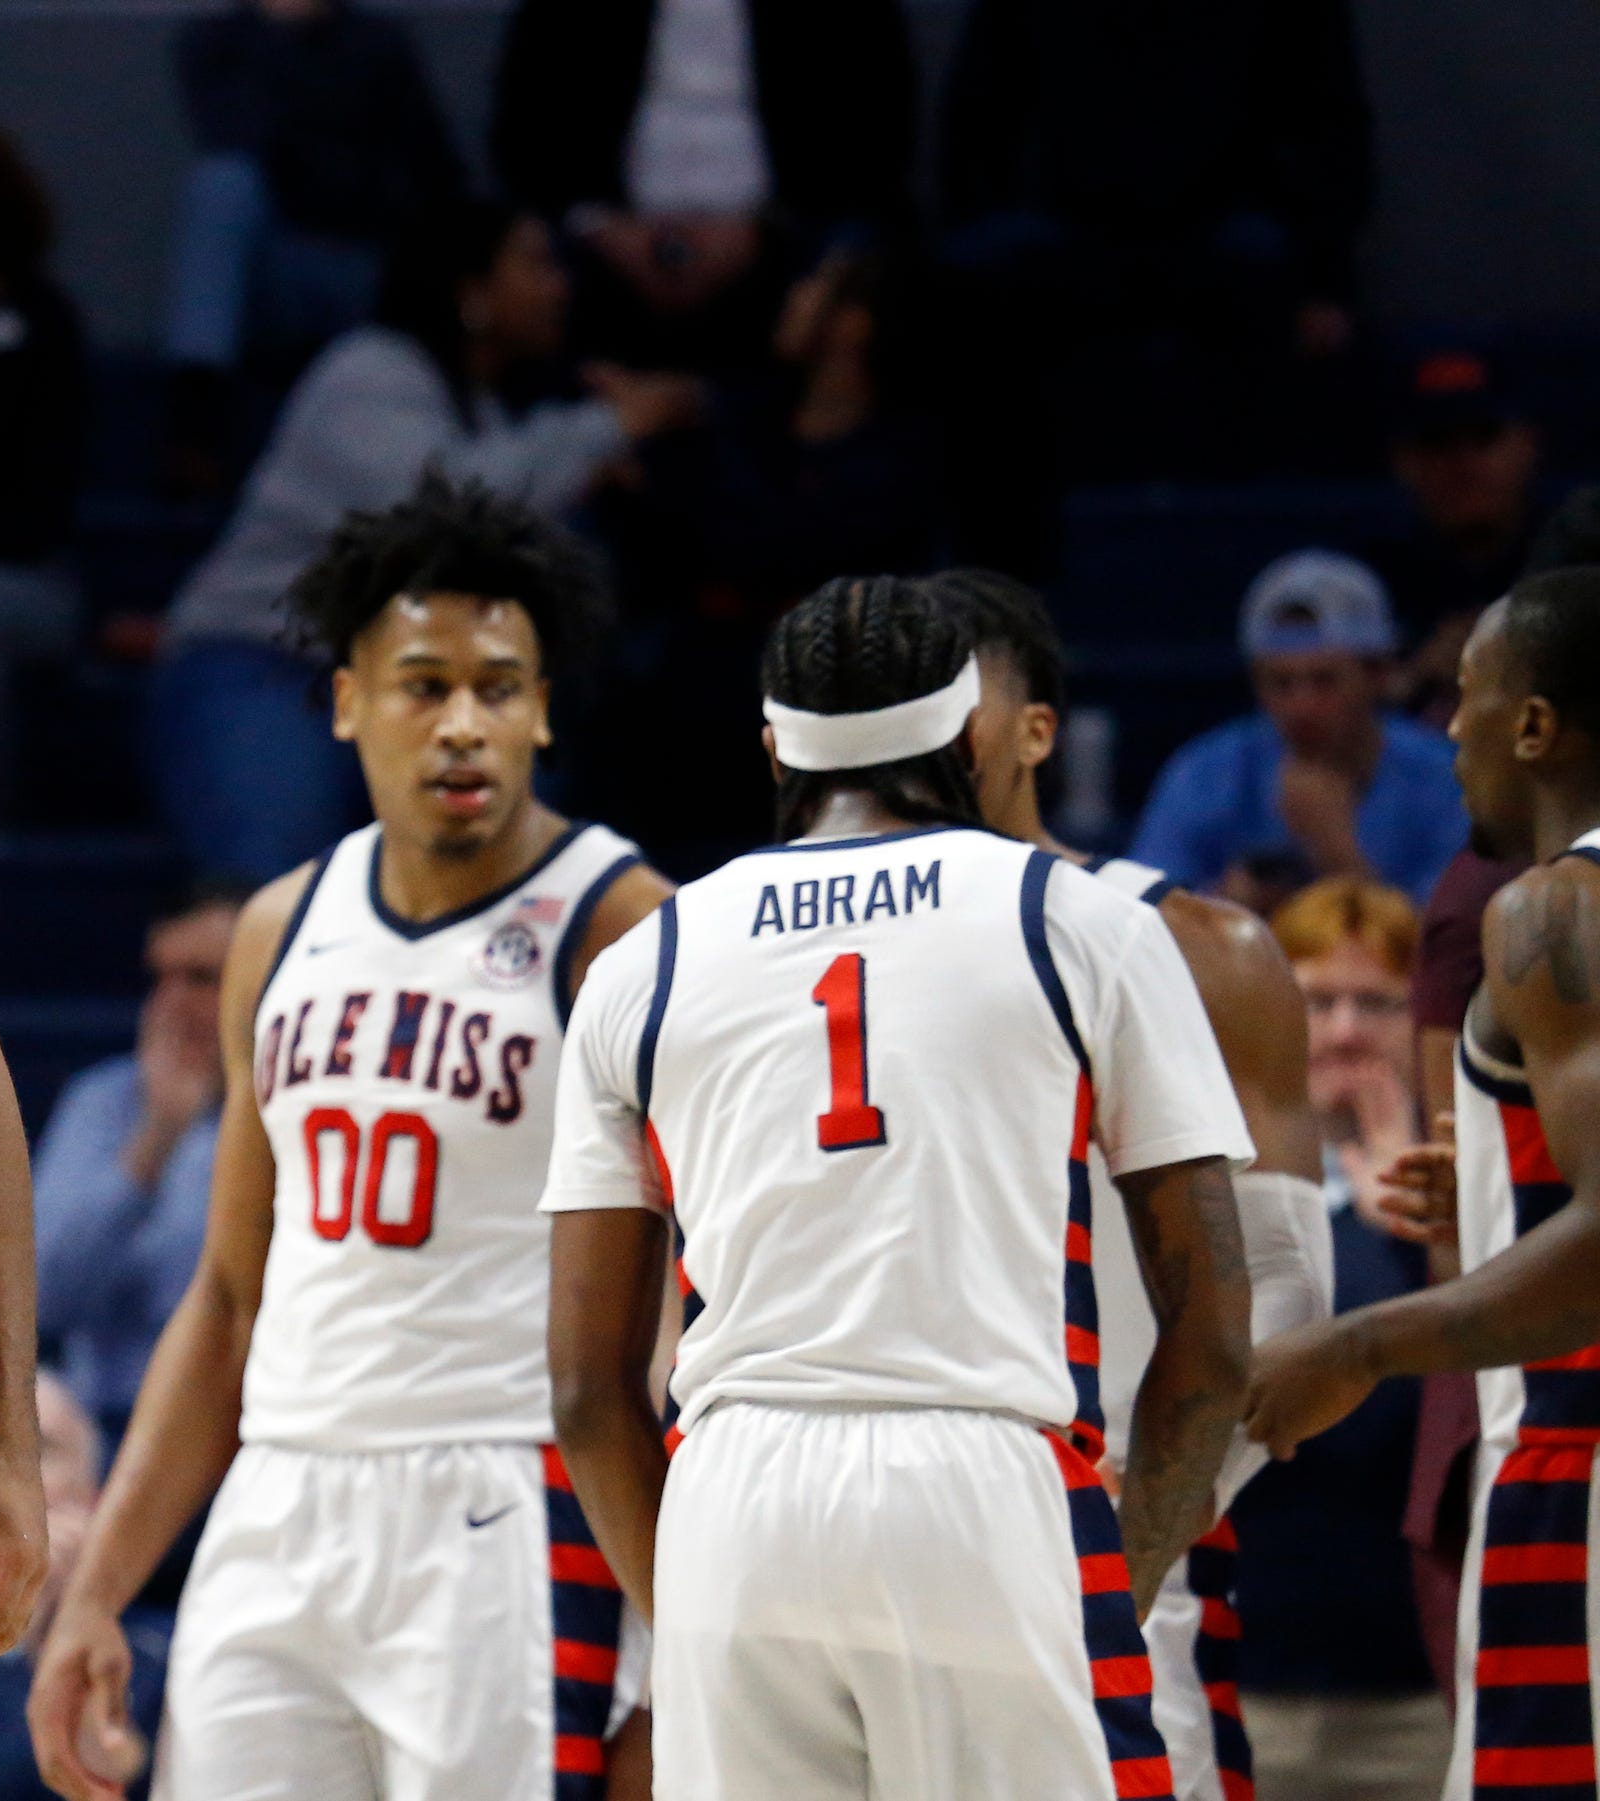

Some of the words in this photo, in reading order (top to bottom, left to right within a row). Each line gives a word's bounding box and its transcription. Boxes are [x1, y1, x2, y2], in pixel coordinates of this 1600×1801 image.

[751, 860, 941, 937] ABRAM
[255, 991, 374, 1108] OLE
[376, 991, 536, 1126] MISS
[811, 952, 888, 1153] 1
[303, 1107, 438, 1249] 00
